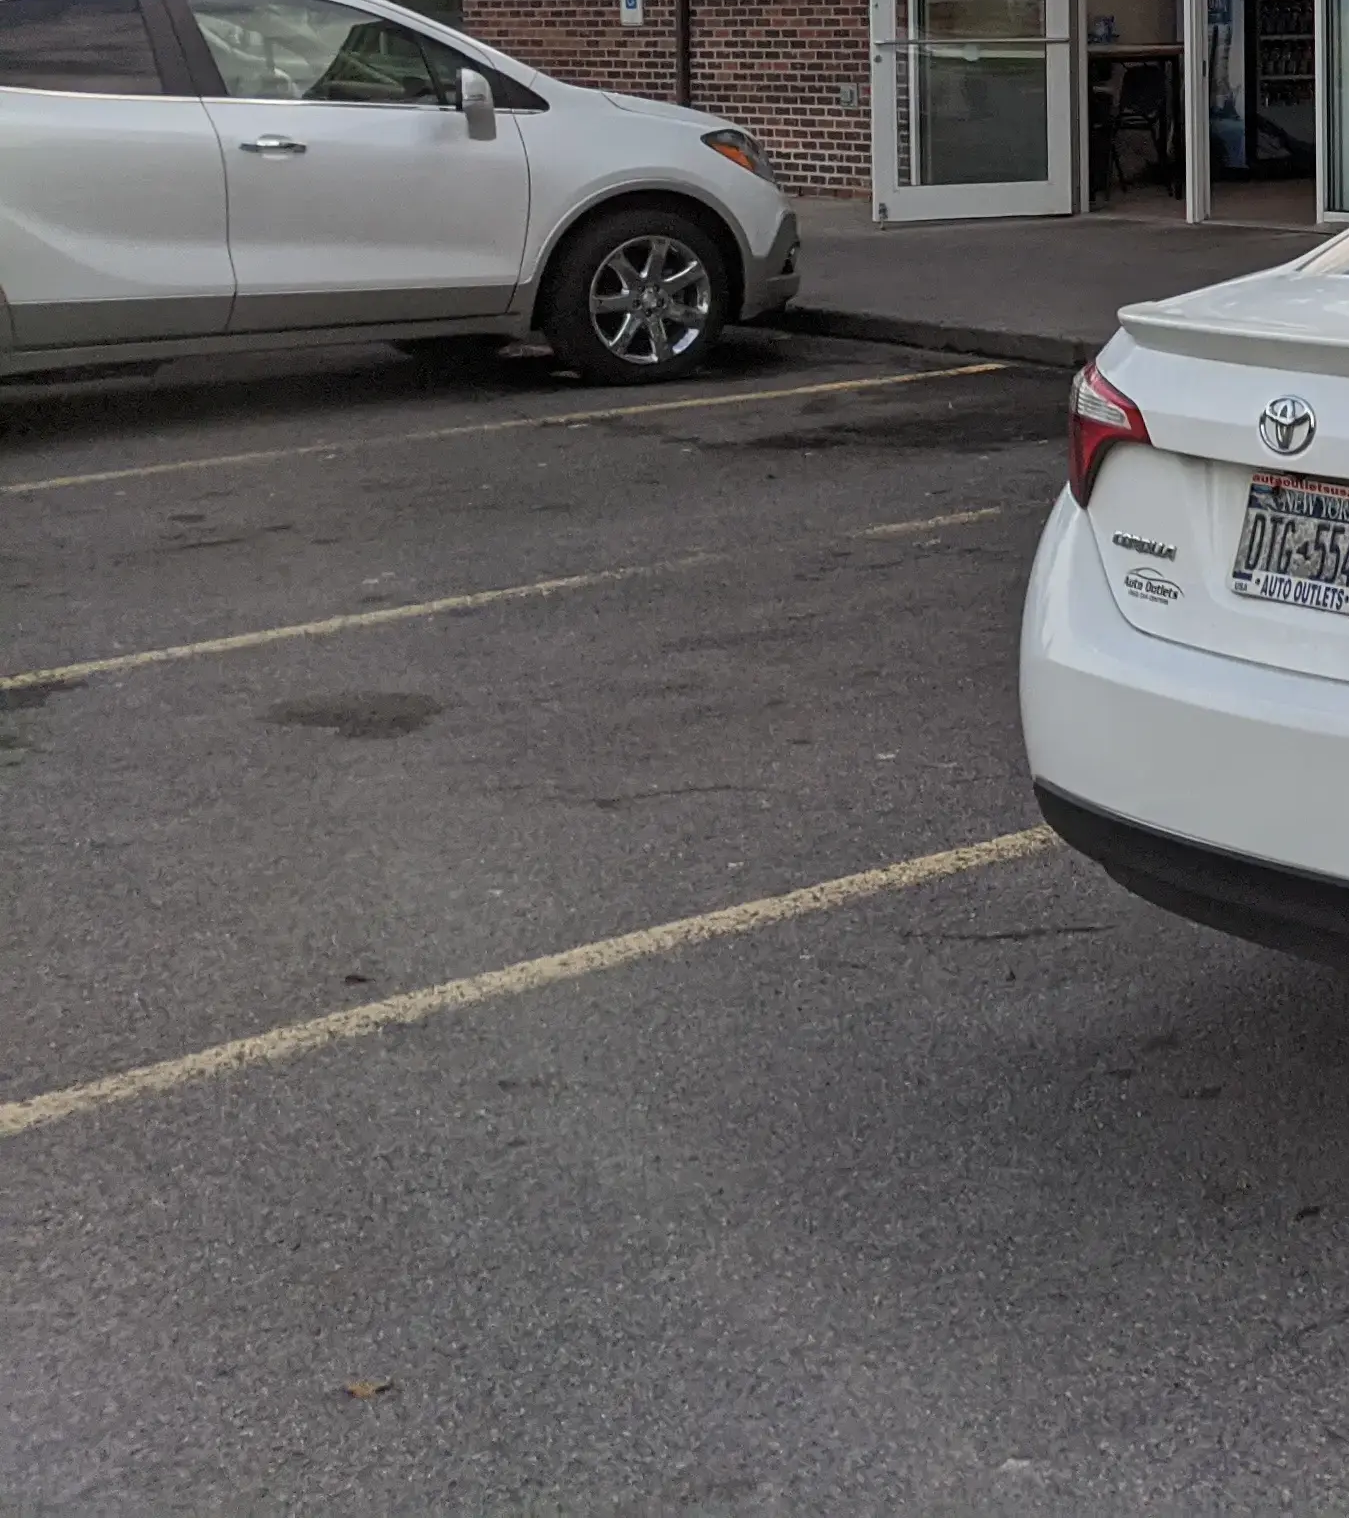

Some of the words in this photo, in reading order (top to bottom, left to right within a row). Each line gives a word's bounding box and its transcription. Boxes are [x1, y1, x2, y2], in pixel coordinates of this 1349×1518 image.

[1281, 491, 1319, 516] NEW
[1145, 580, 1179, 601] Outlets
[1234, 582, 1248, 592] USA
[1260, 575, 1291, 598] AUTO
[1293, 579, 1346, 611] OUTLETS
